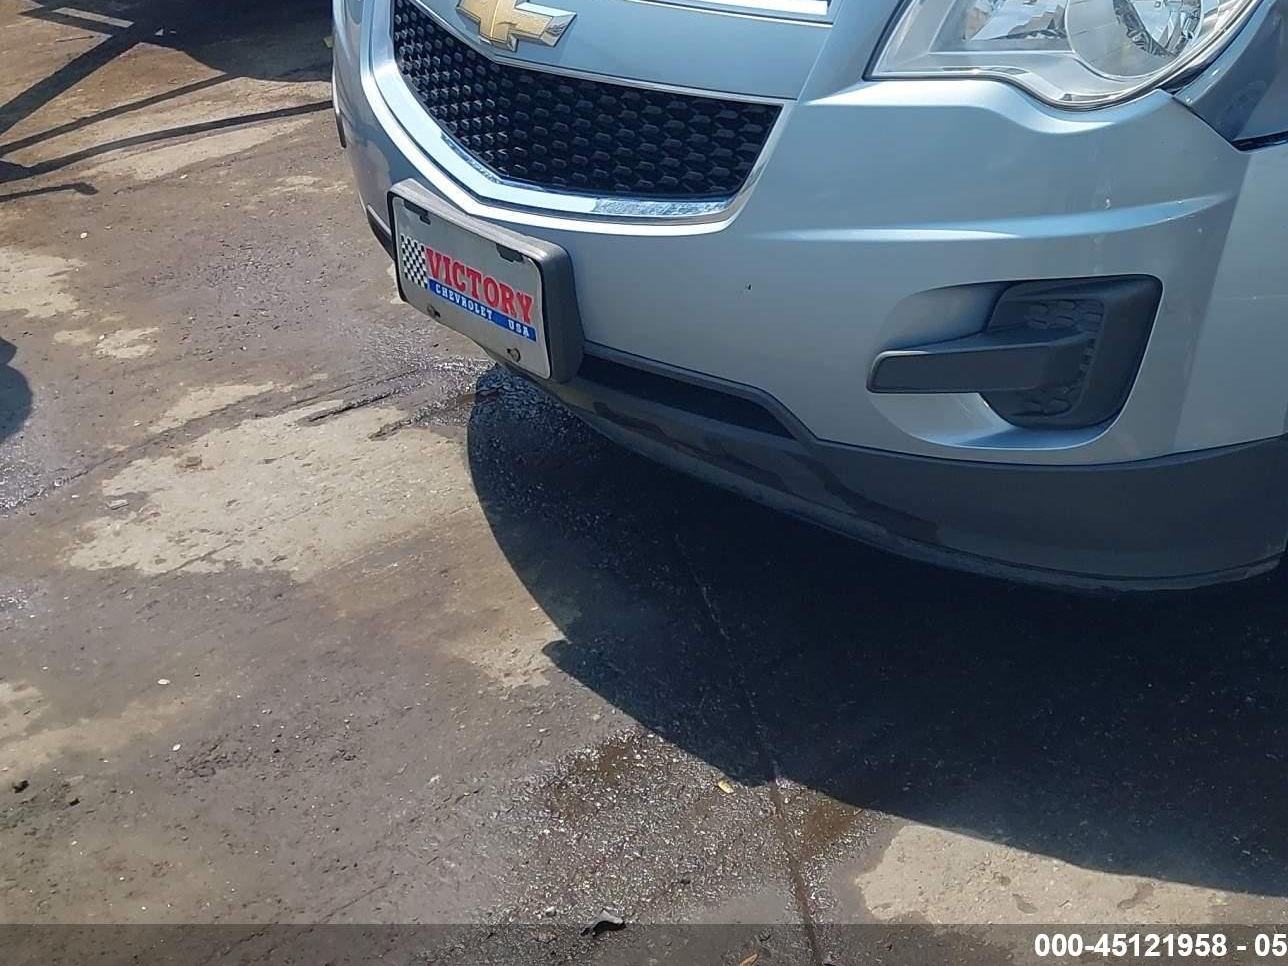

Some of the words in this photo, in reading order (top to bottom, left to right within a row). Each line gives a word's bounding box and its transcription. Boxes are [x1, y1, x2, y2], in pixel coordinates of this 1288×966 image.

[426, 247, 533, 325] VICTORY
[435, 284, 492, 319] CHEVROLET
[507, 318, 530, 337] USA
